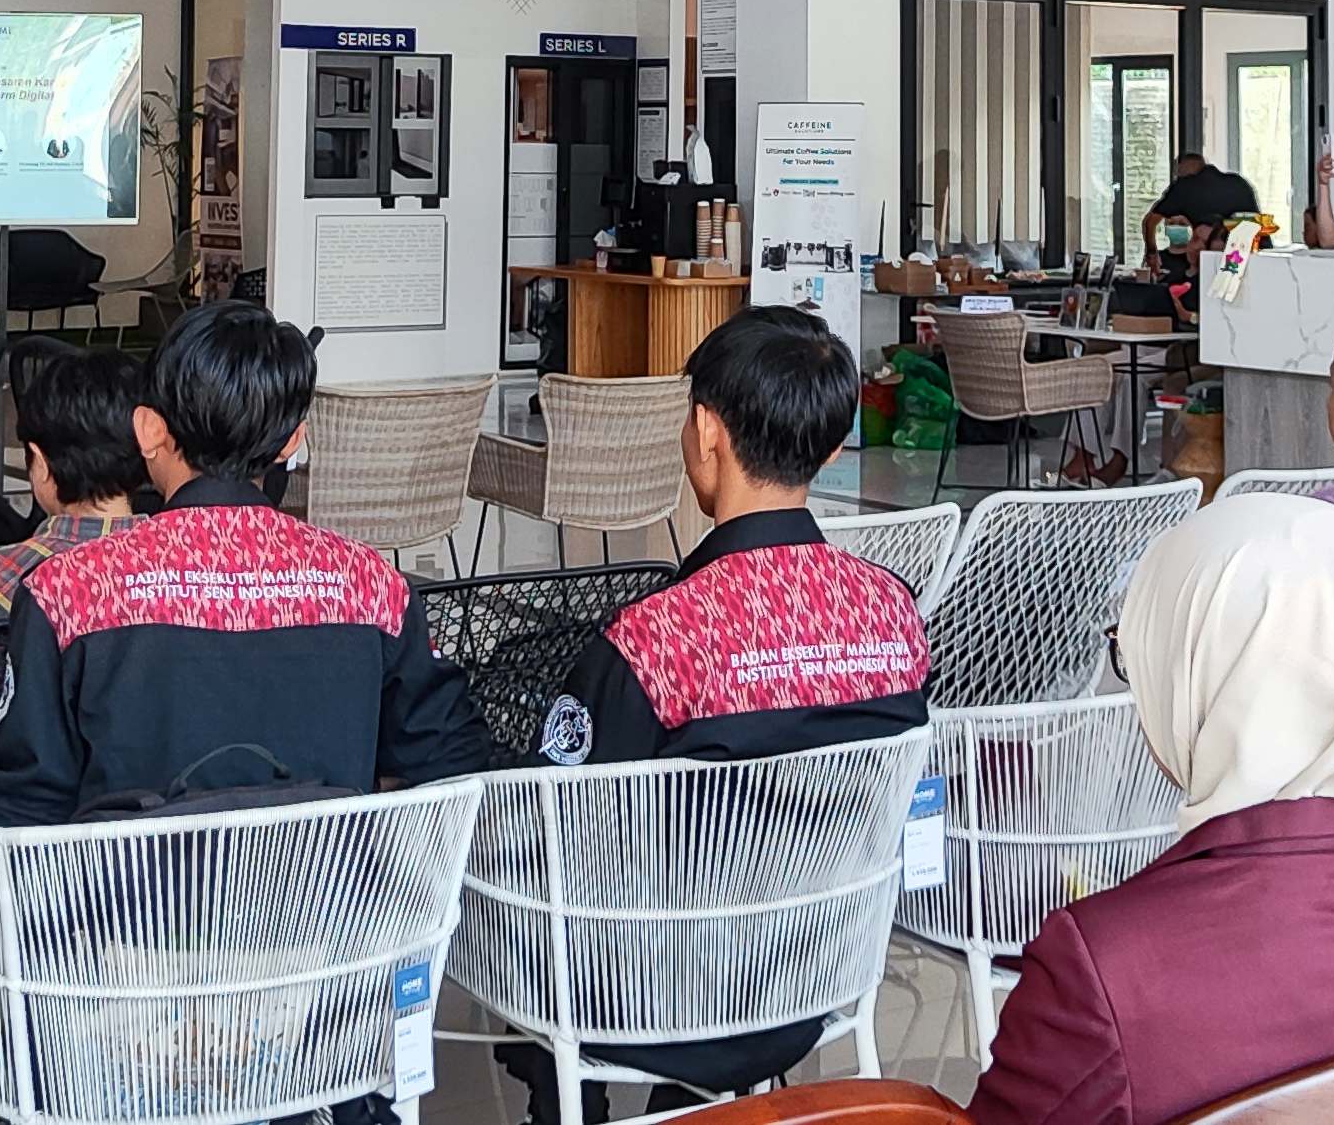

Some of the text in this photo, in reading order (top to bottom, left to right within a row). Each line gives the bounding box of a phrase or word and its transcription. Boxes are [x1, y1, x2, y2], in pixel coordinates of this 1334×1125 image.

[338, 33, 406, 47] SERIES R
[545, 38, 606, 53] SERIES L
[19, 90, 54, 102] Digital
[126, 570, 344, 586] BADAN EKSEKUTIF MAHASISWA
[130, 585, 343, 600] INSTITUT SENI INDONESIA BALI
[731, 641, 910, 668] BADAN EKSEKUTIF MAHASISWA
[738, 657, 910, 684] INSTITUT SENI INDONESIA BALI
